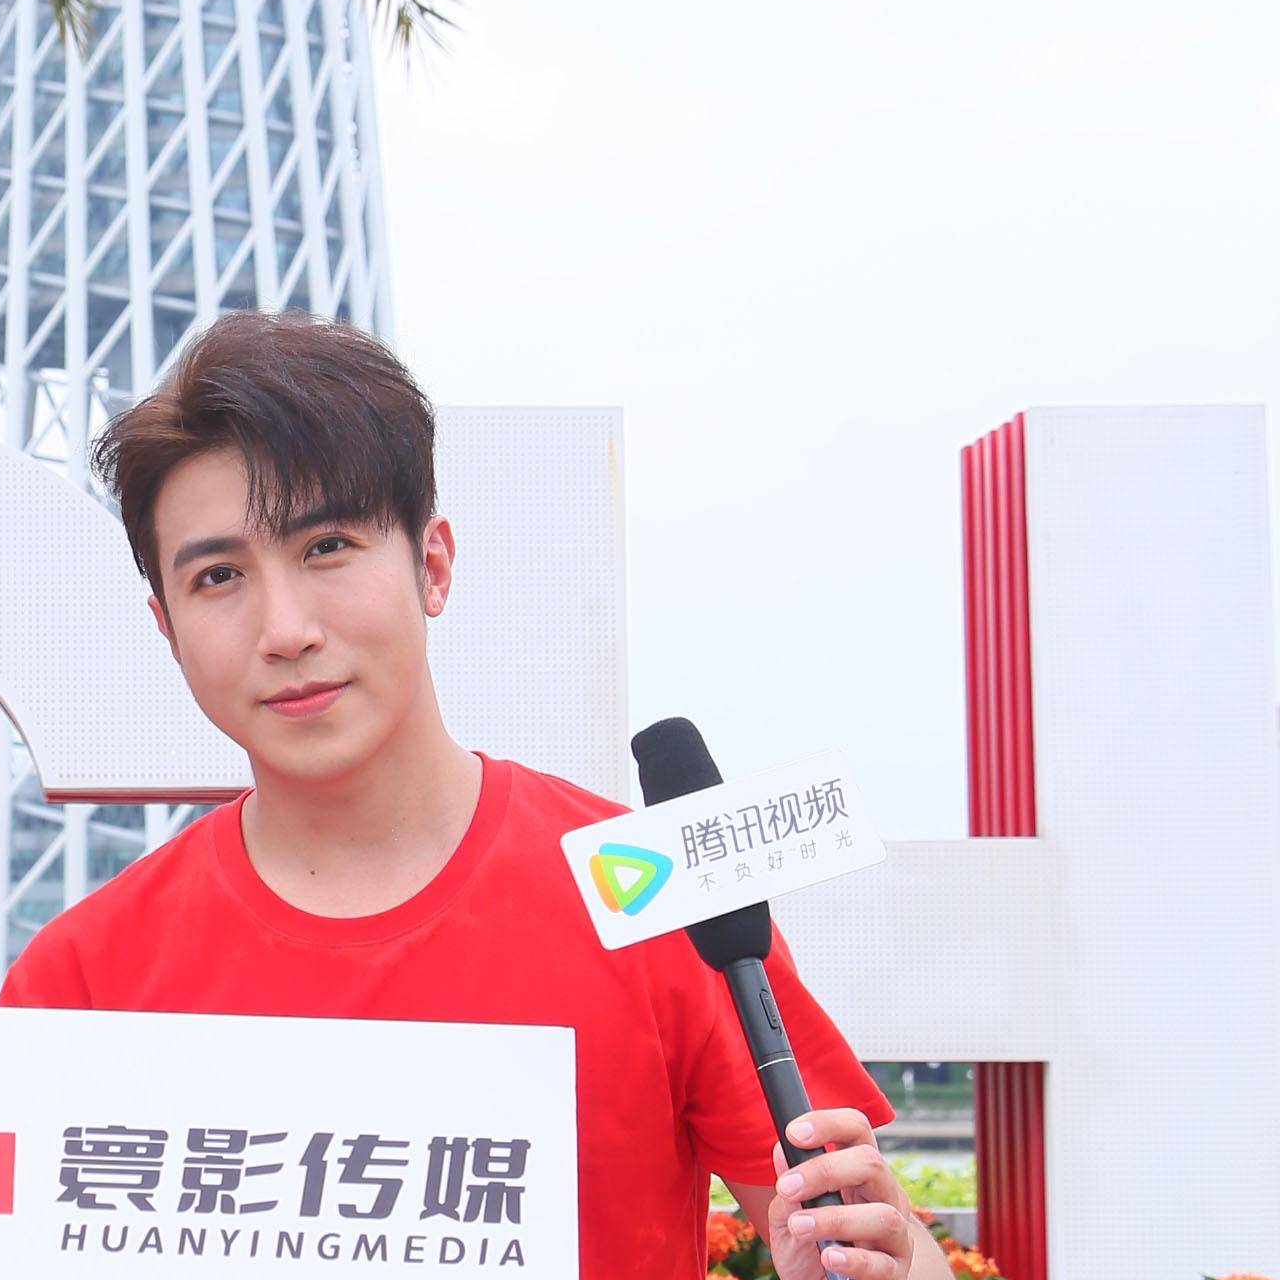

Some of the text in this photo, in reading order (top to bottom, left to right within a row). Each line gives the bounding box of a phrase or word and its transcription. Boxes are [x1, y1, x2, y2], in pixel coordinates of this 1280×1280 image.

[680, 777, 849, 870] 腾讯视频
[698, 829, 854, 893] 不负好时光
[55, 1125, 532, 1224] 寰影传媒
[60, 1222, 526, 1267] HUANYINGMEDIA
